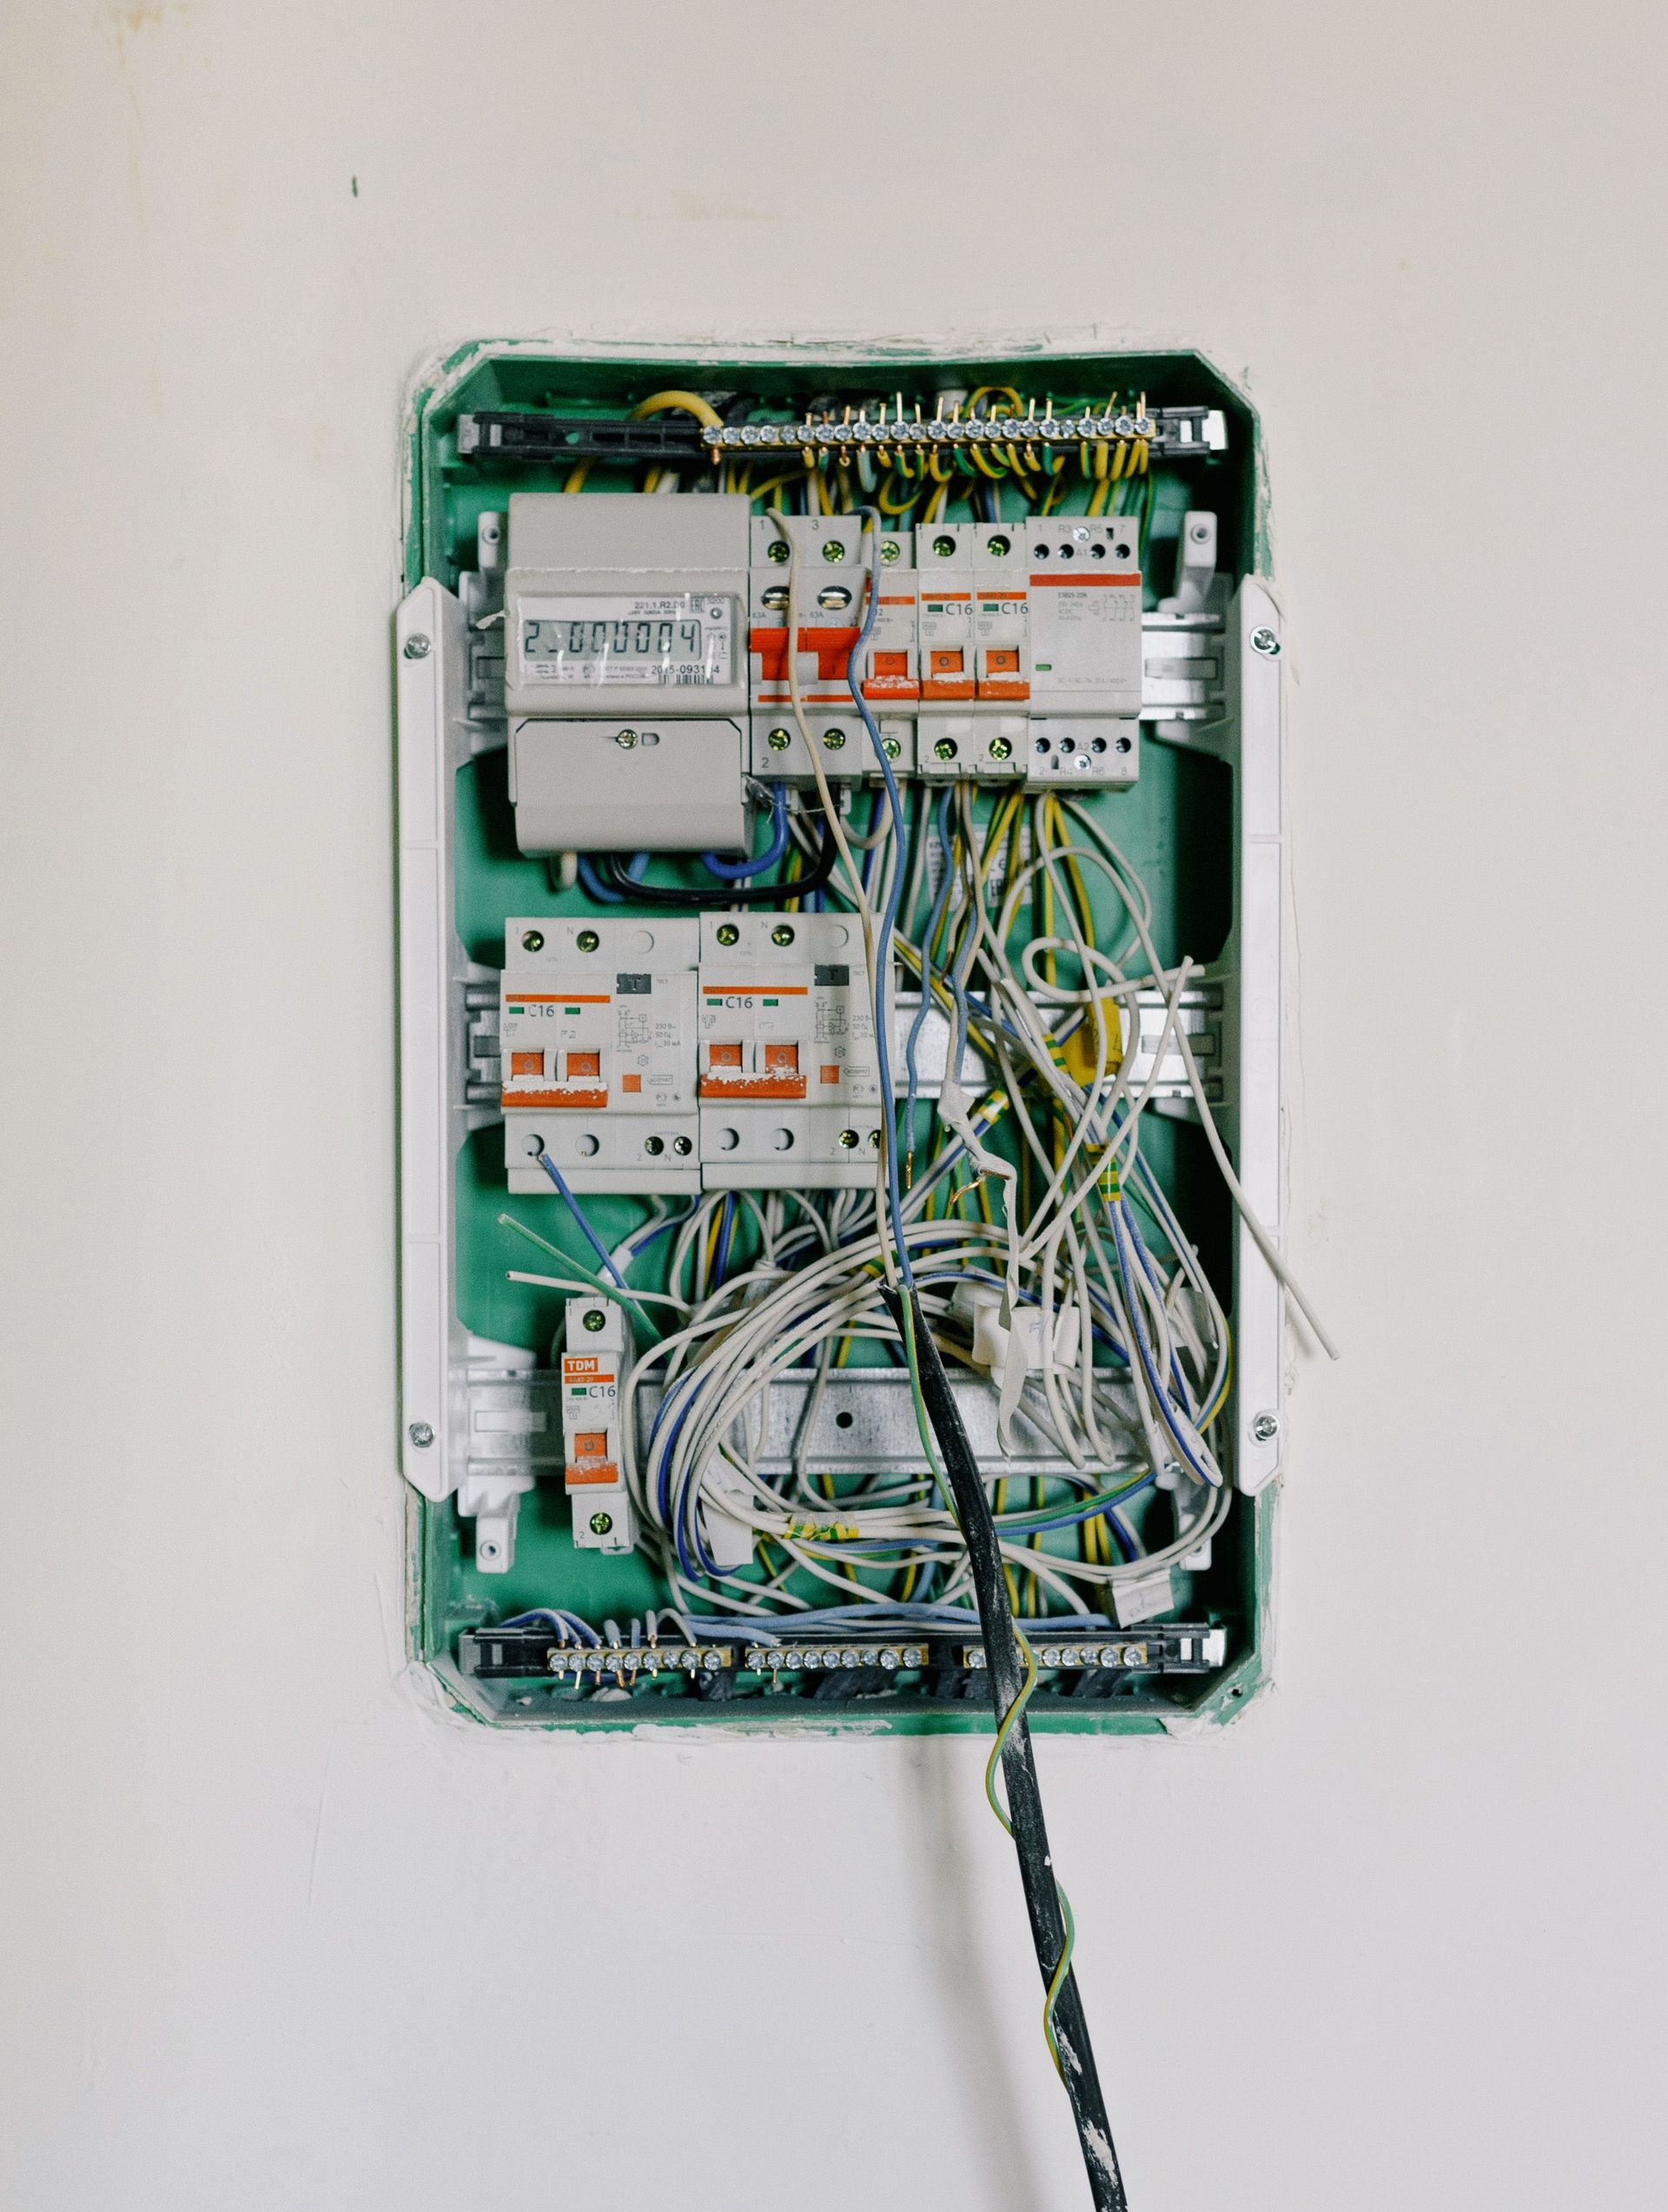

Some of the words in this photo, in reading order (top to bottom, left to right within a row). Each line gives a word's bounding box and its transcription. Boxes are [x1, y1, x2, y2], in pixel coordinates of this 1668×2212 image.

[811, 520, 819, 530] 3
[945, 603, 973, 615] C16
[1001, 602, 1029, 614] C16
[761, 757, 769, 768] 2
[725, 997, 753, 1009] C16
[528, 1004, 555, 1017] C16
[567, 1361, 595, 1371] TDM
[589, 1386, 616, 1398] C16
